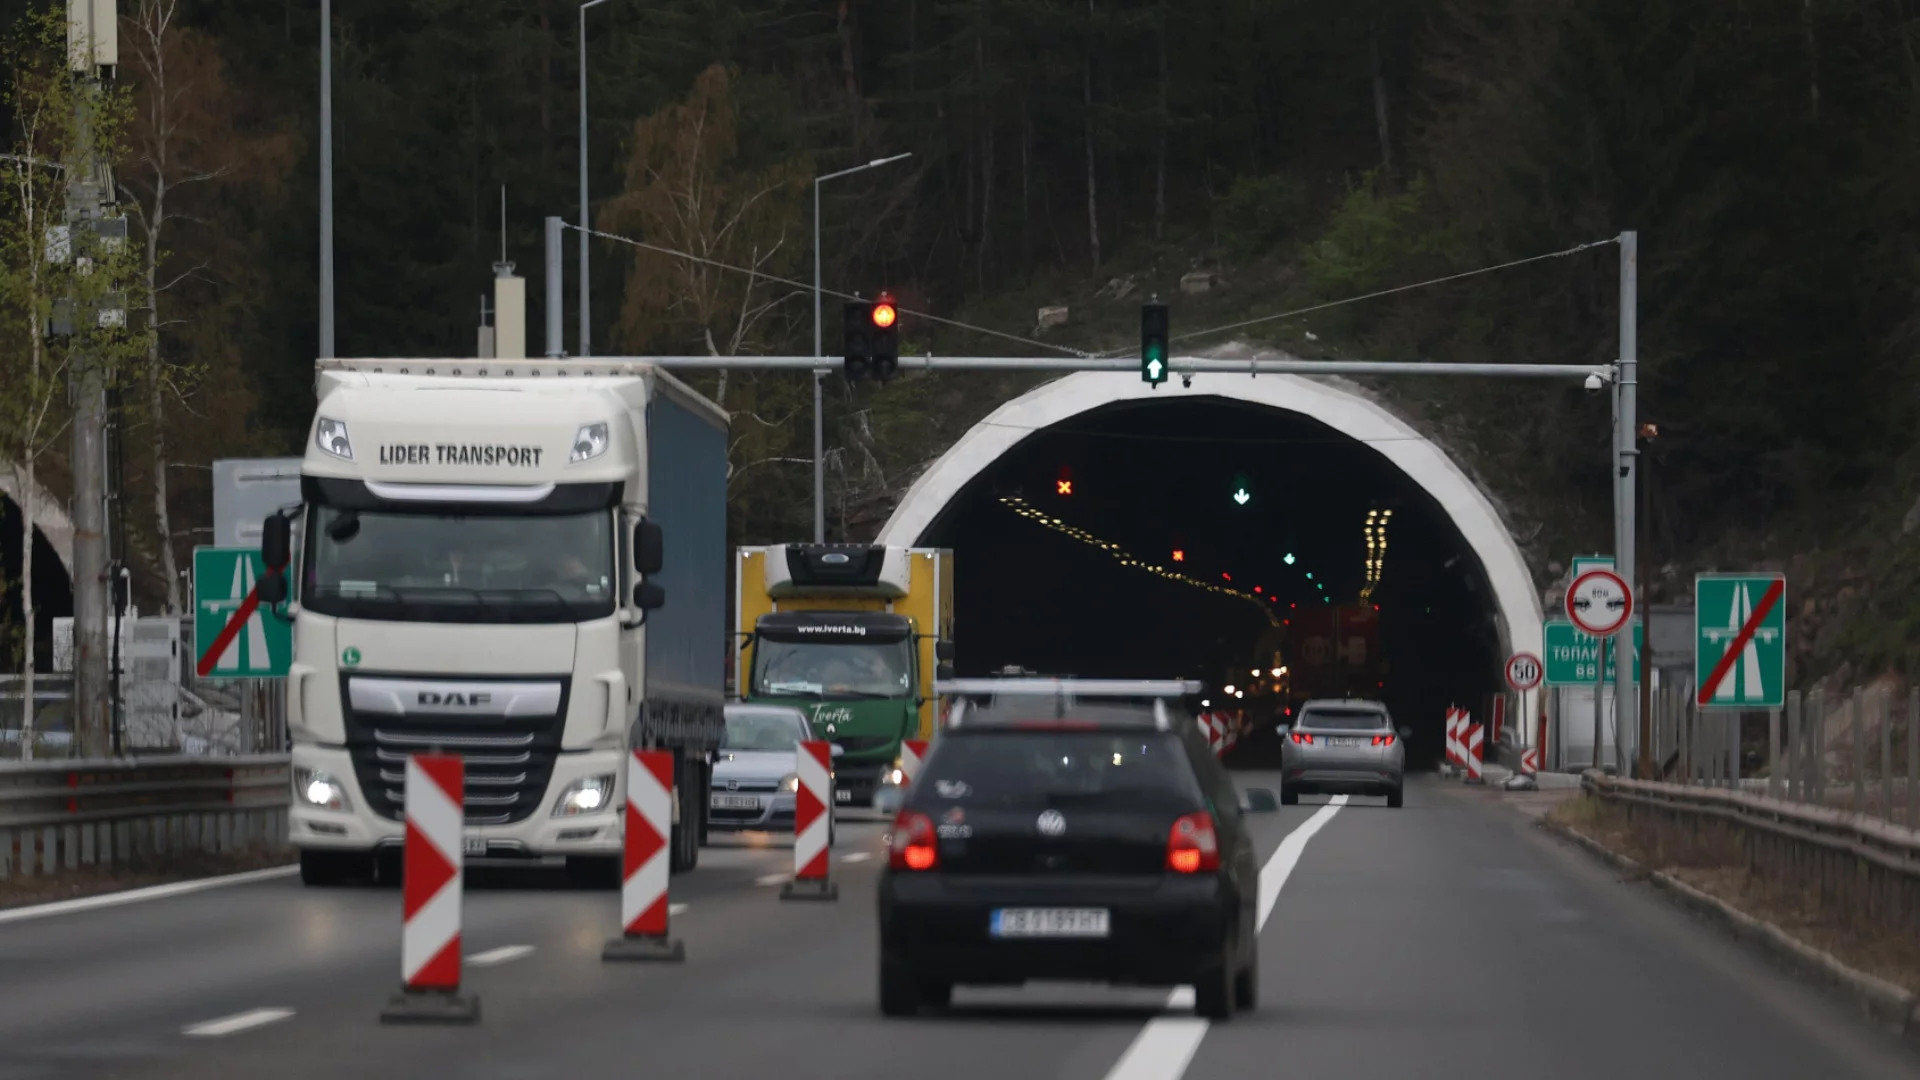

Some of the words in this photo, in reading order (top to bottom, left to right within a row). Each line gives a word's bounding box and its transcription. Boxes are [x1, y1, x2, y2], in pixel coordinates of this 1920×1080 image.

[380, 444, 430, 465] LIDER
[435, 444, 543, 467] TRANSPORT
[797, 624, 866, 636] www.iverta.bg
[1514, 661, 1536, 681] 50
[417, 692, 492, 706] DAF
